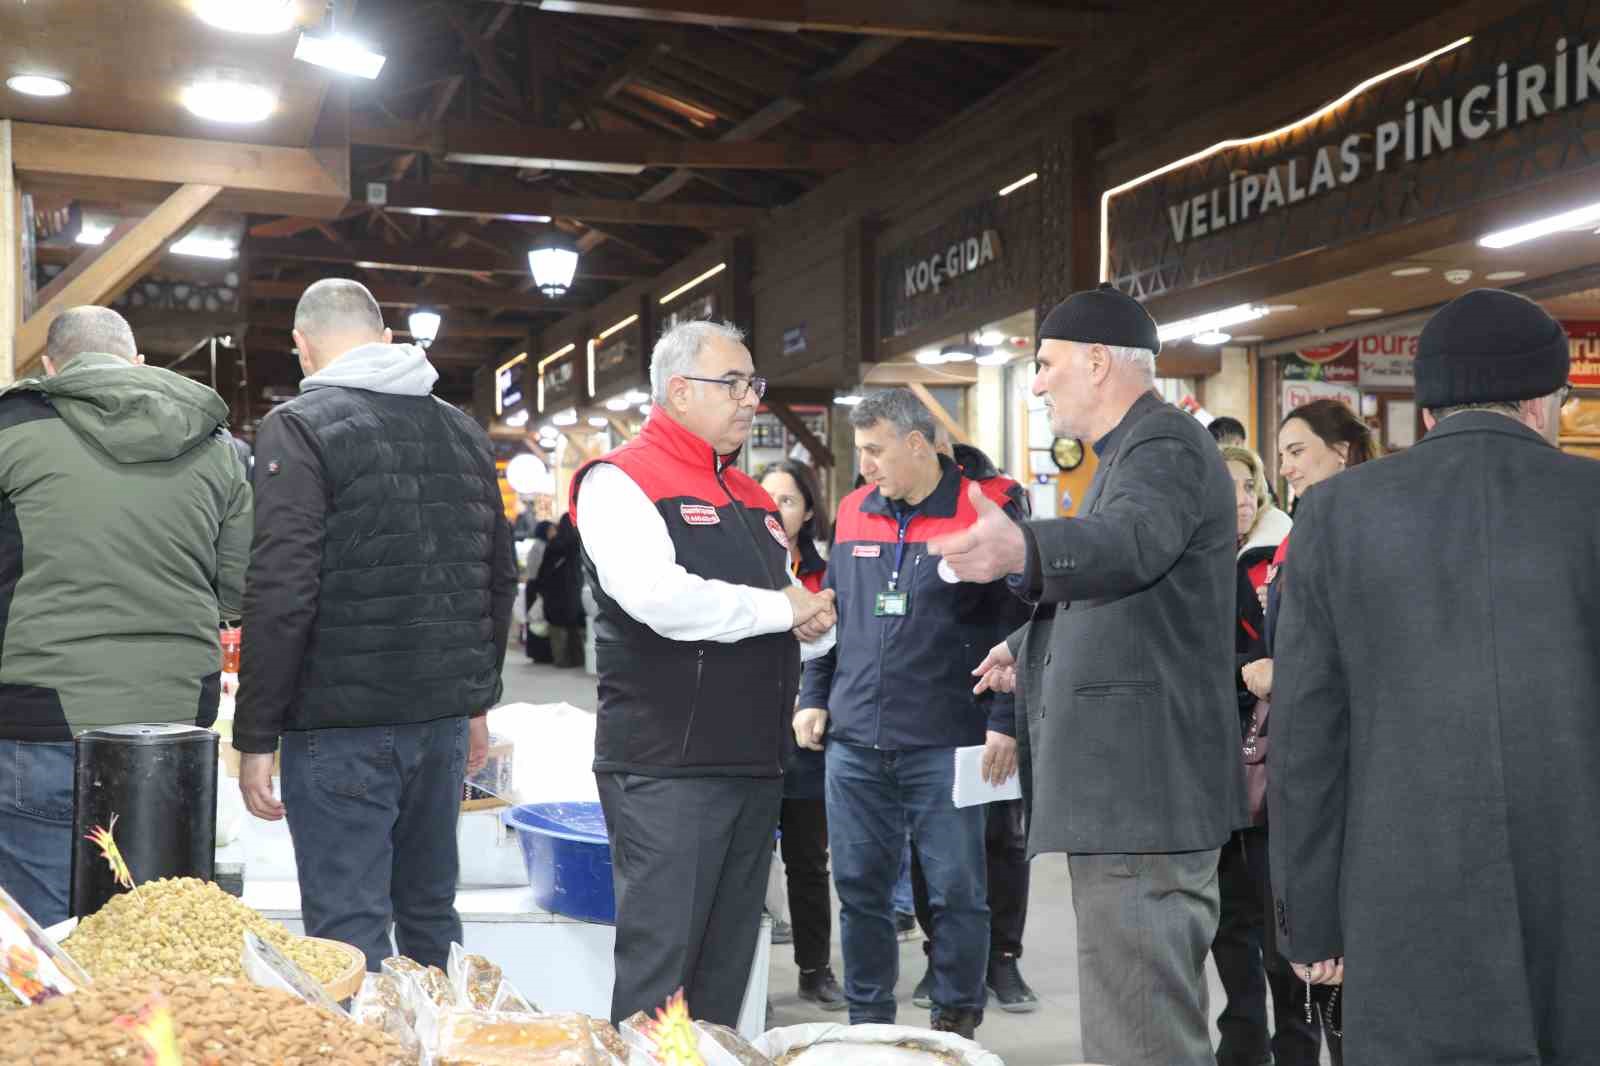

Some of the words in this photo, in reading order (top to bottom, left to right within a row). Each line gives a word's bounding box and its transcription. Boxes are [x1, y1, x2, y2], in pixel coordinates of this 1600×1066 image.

[1169, 134, 1360, 243] VELİPALAS
[905, 254, 941, 296] KOÇ
[946, 230, 998, 278] GIDA
